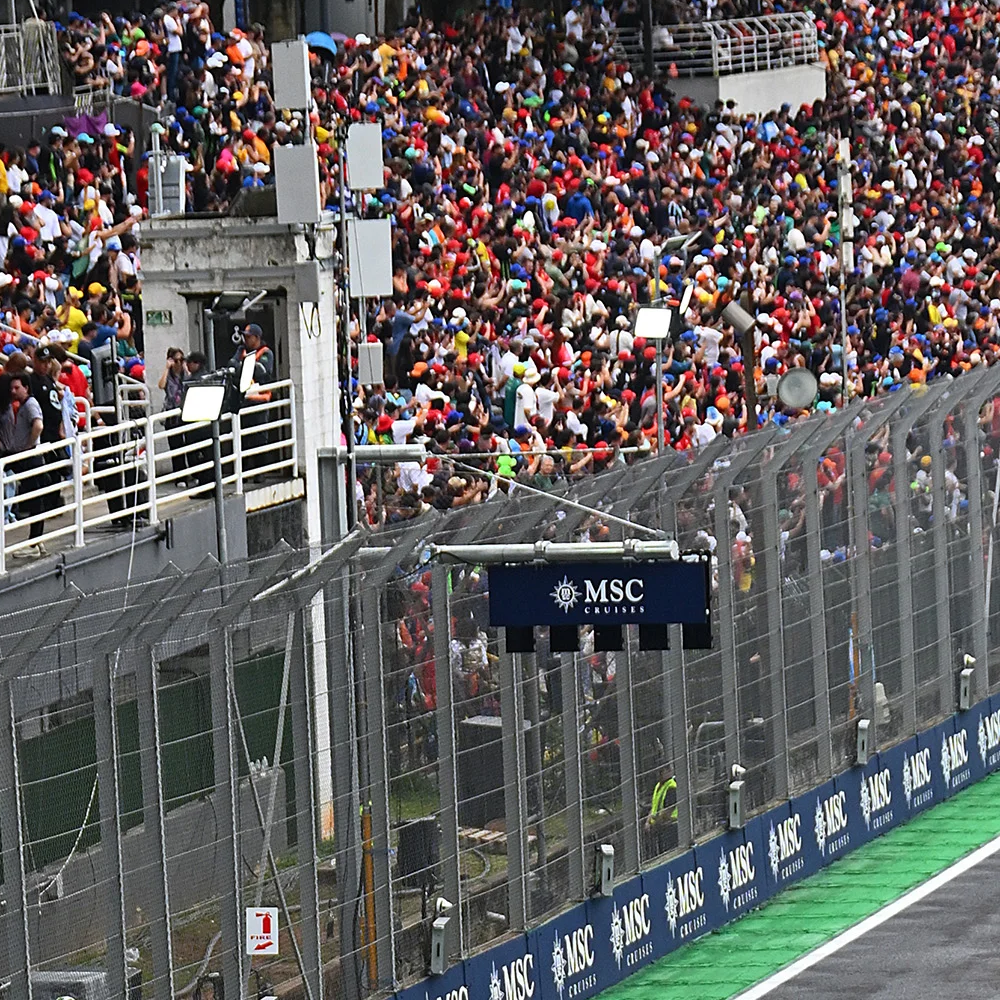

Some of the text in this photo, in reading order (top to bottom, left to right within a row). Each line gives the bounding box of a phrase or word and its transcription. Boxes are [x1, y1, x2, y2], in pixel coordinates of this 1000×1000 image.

[584, 579, 644, 602] MSC
[584, 605, 645, 614] CRUISES
[910, 747, 932, 790] MSC
[949, 728, 969, 770] MSC
[868, 768, 892, 812] MSC
[824, 790, 848, 836] MSC
[777, 813, 802, 861] MSC
[729, 841, 756, 890] MSC
[676, 866, 705, 918] MSC
[733, 886, 758, 910] CRUISES
[622, 893, 651, 946] MSC
[679, 913, 707, 939] CRUISES
[564, 924, 595, 976] MSC
[626, 941, 653, 967] CRUISES
[502, 953, 535, 1000] MSC
[568, 973, 597, 998] CRUISES
